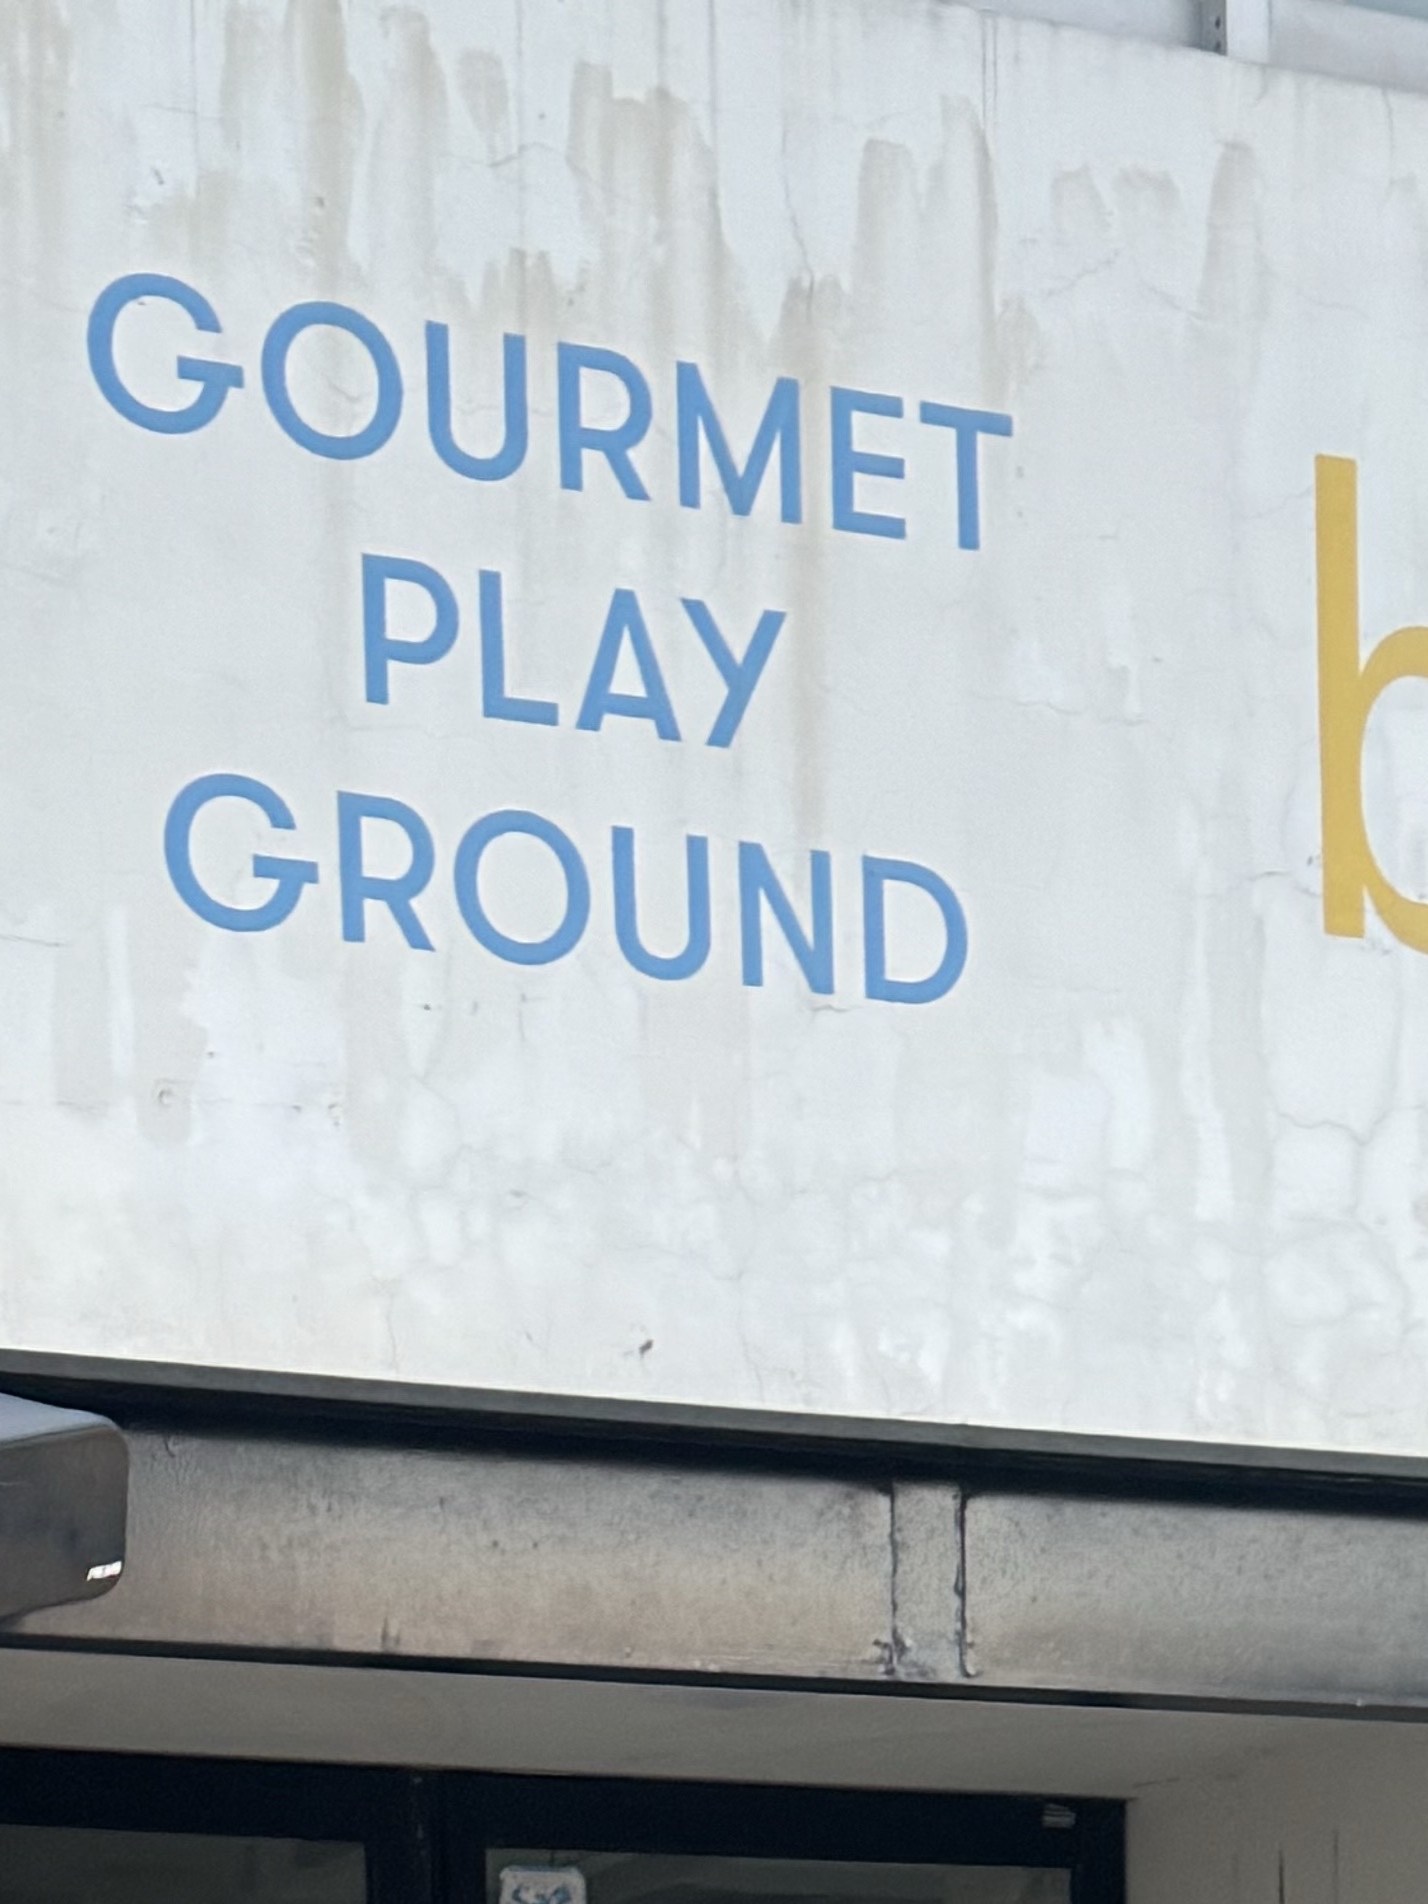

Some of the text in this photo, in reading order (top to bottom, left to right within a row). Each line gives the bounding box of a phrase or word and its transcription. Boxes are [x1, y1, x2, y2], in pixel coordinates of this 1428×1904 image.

[87, 273, 1013, 551] GOURMET
[362, 555, 785, 749] PLAY
[163, 774, 968, 1004] GROUND
